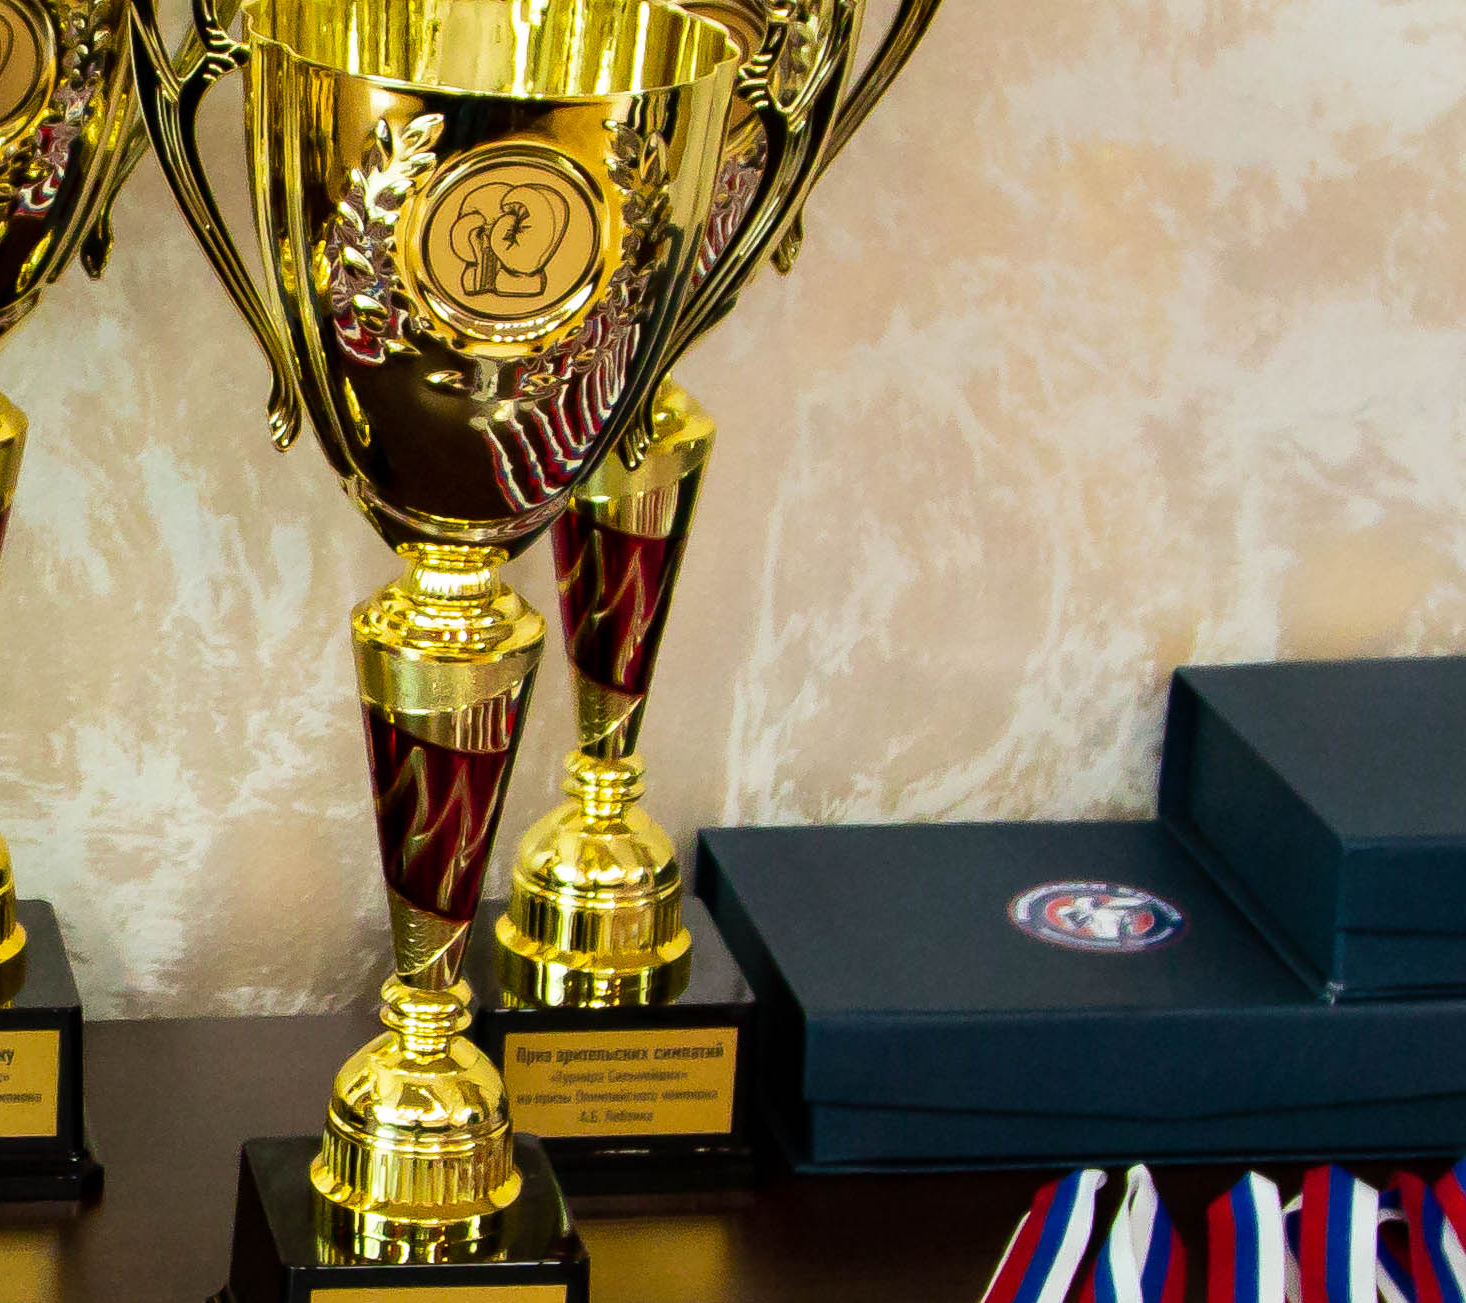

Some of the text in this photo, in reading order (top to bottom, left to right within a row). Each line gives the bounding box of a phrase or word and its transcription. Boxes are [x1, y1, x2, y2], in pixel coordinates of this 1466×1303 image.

[515, 1041, 724, 1067] Приз зрительских симпатий
